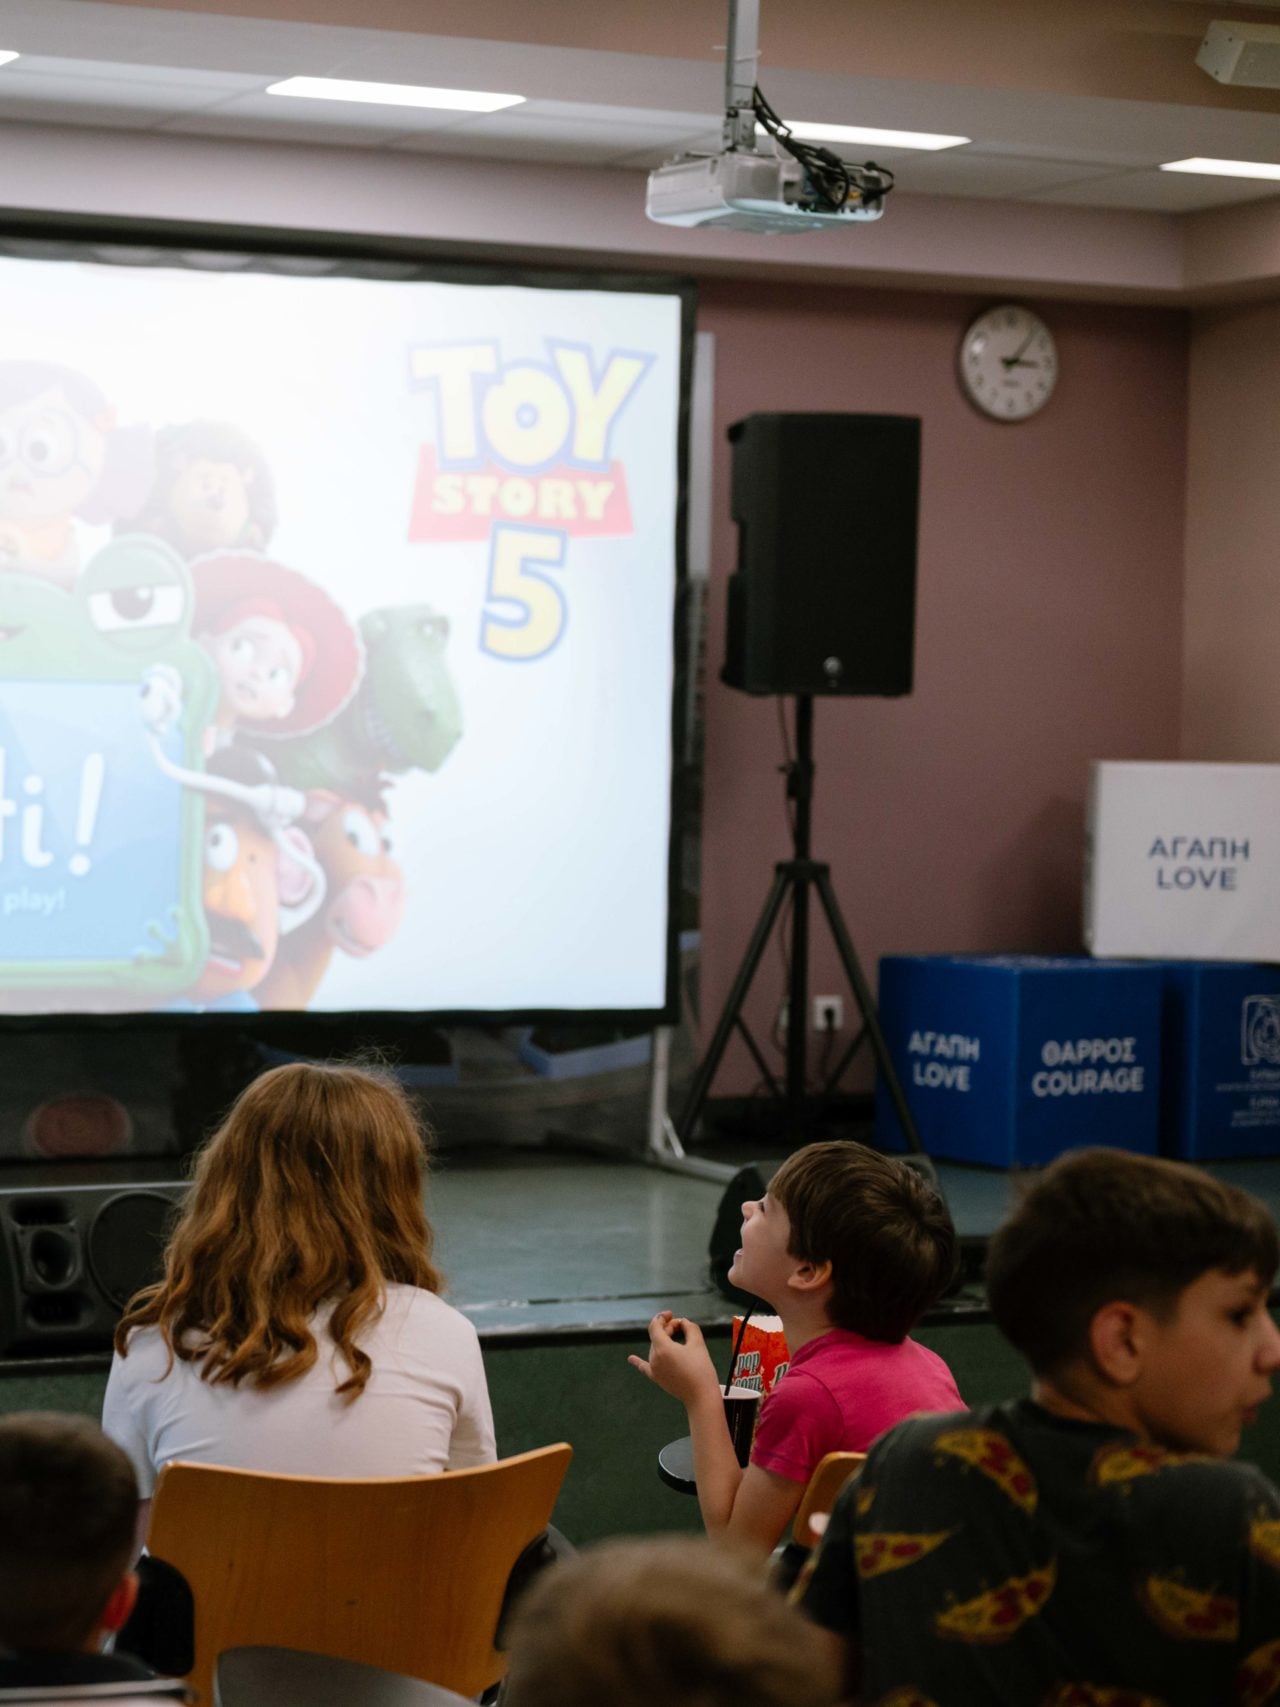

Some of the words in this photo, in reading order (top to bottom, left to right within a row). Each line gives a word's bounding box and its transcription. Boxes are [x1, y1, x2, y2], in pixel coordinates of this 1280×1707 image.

[408, 337, 658, 475] TOY
[431, 475, 616, 521] STORY
[479, 520, 569, 663] 5
[1147, 836, 1250, 861] ΑΓΑΠΗ
[1157, 866, 1238, 891] LOVE
[2, 885, 66, 917] play!
[909, 1032, 980, 1061] ΑΓΑΠΗ
[1042, 1037, 1136, 1066] ΘΑΡΡΟΣ
[913, 1062, 970, 1091] LOVE
[1032, 1067, 1144, 1097] COURAGE
